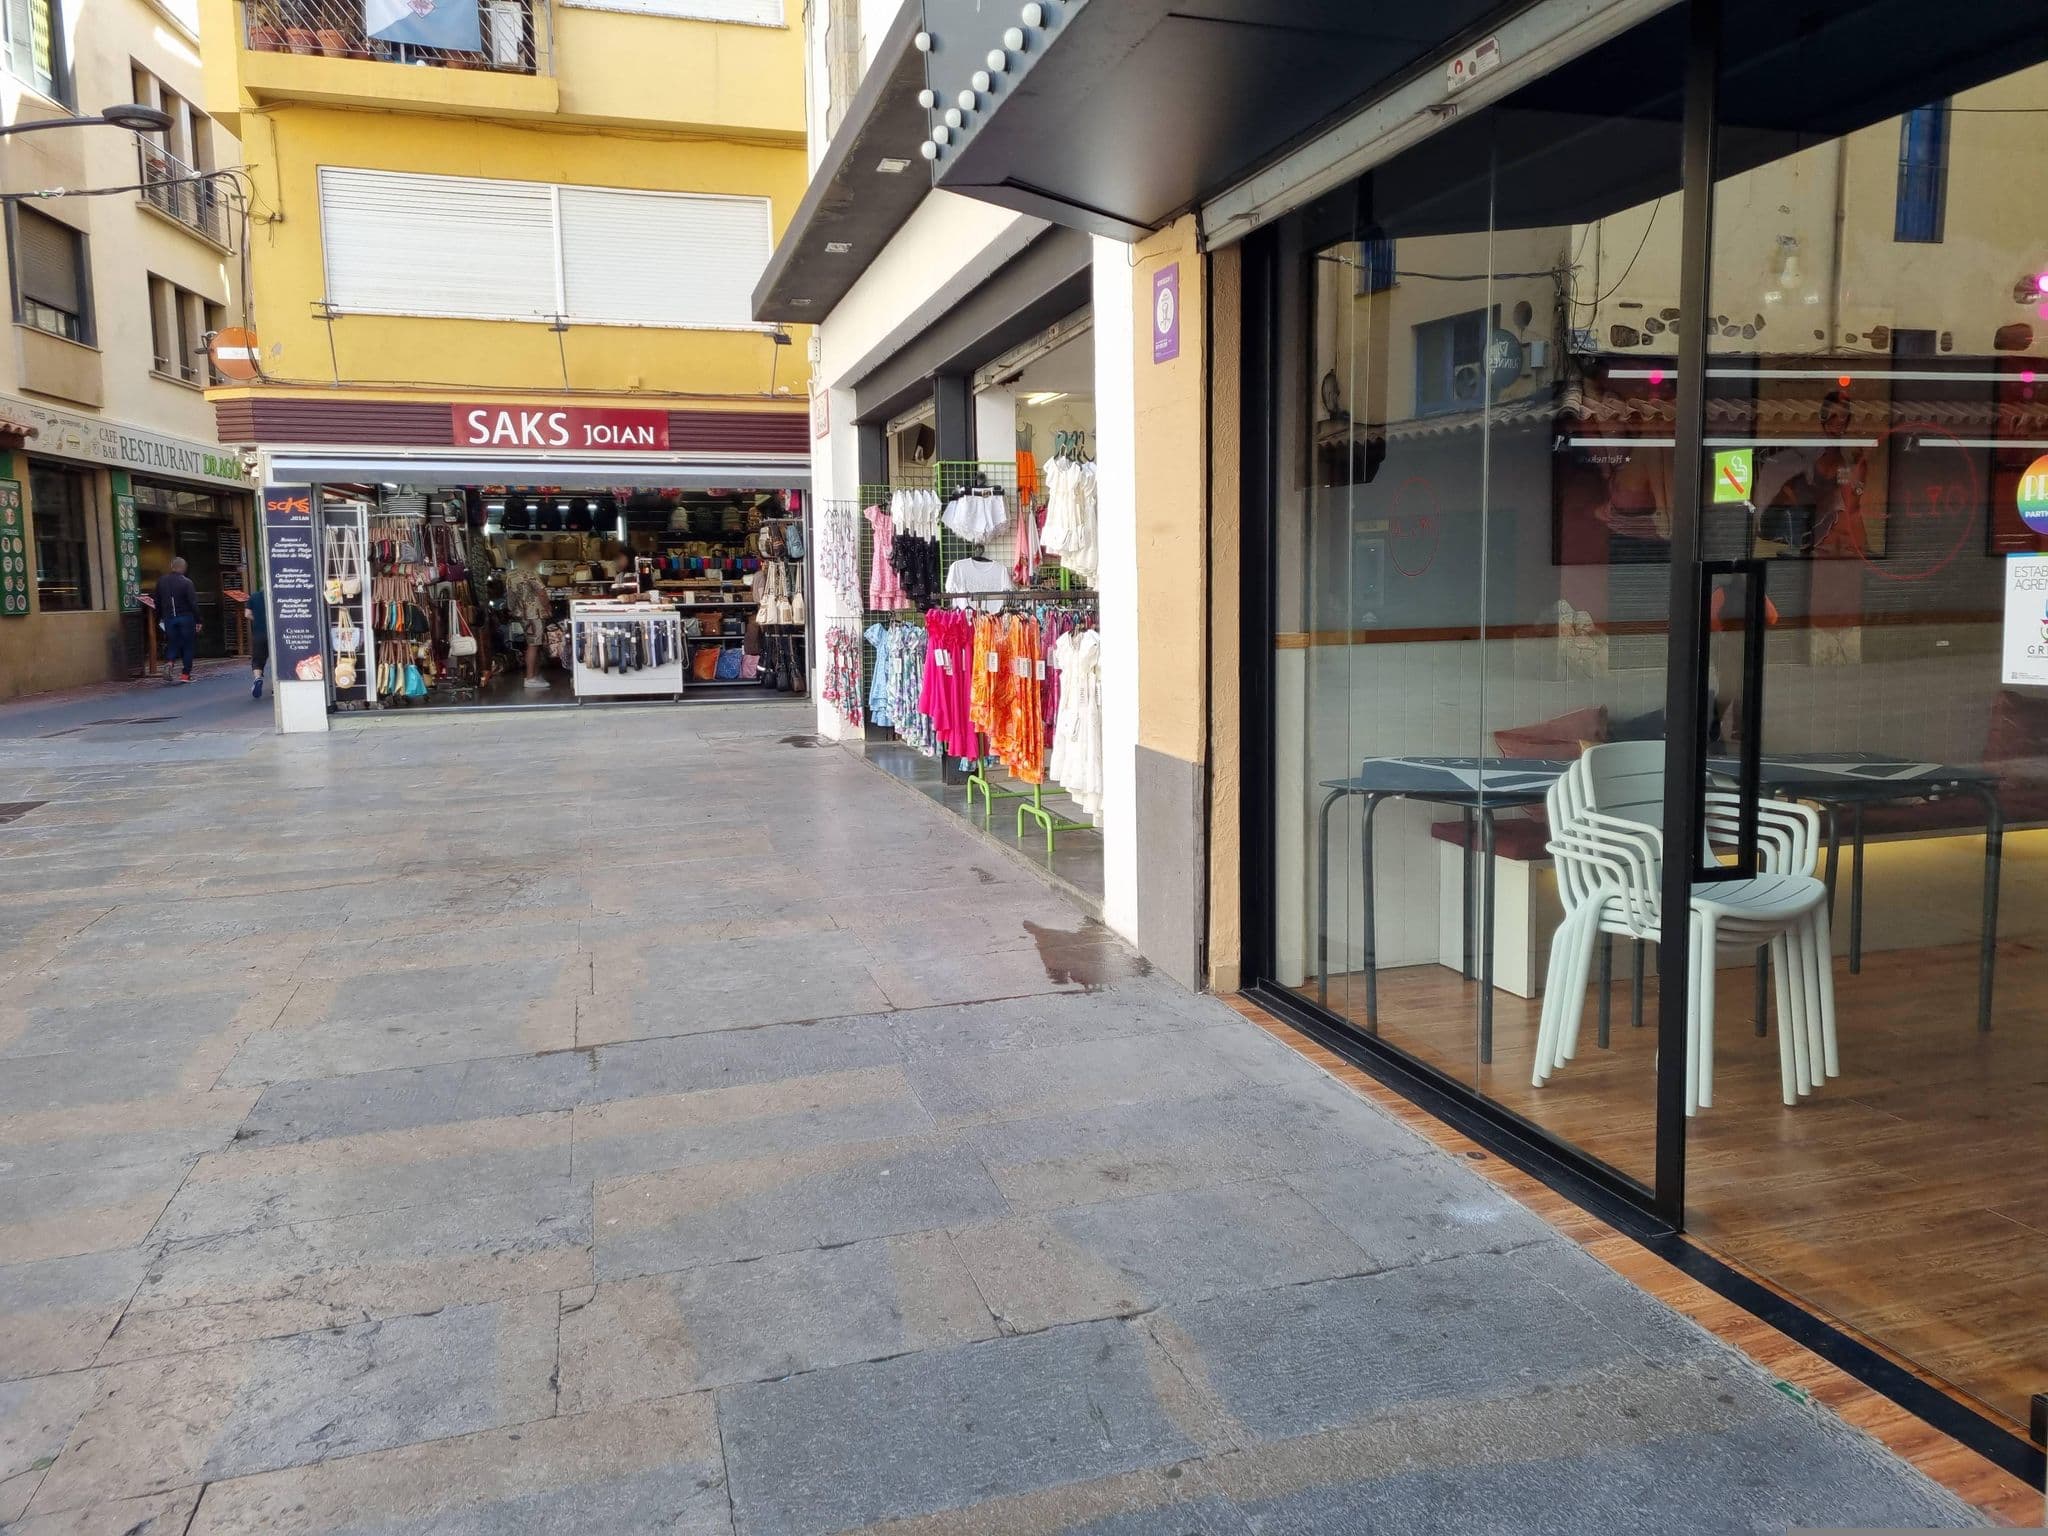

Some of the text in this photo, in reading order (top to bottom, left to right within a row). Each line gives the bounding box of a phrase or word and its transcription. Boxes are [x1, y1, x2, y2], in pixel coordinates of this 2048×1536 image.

[468, 410, 655, 446] SAKS JOIAN
[103, 445, 119, 459] BAR
[119, 435, 242, 481] RESTAURANT DRAGÓ
